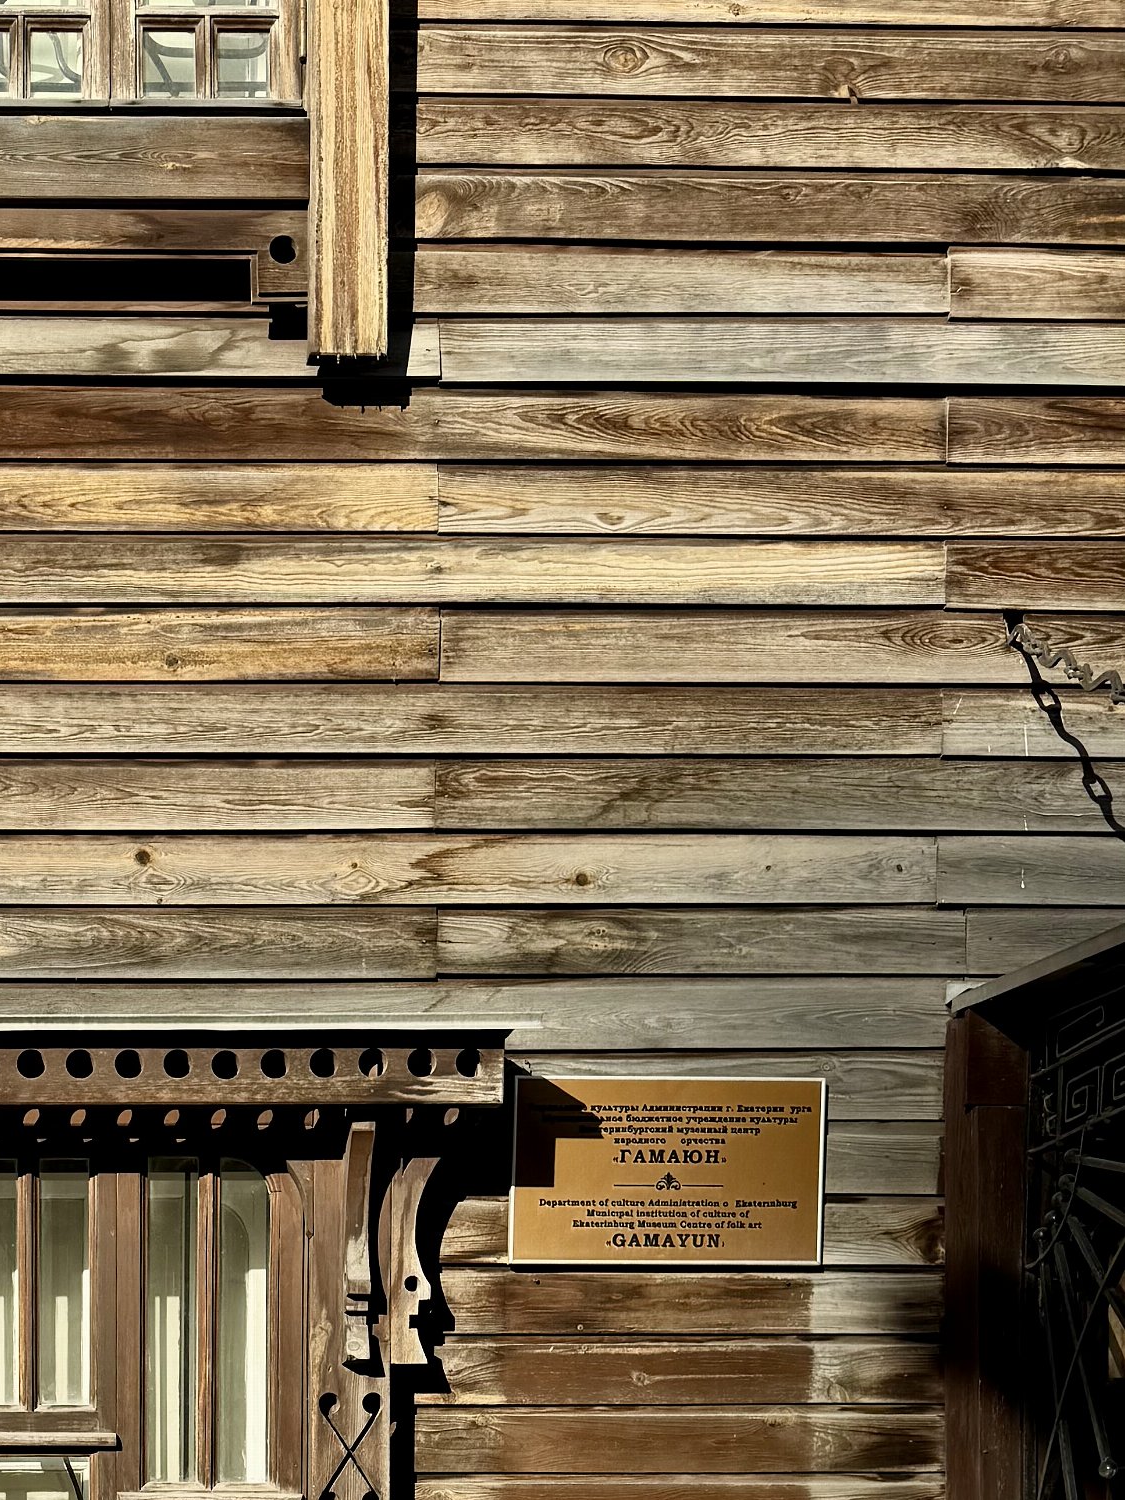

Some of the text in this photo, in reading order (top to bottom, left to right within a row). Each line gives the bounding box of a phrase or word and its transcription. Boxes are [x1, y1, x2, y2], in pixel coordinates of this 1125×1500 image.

[591, 1104, 638, 1113] культуры
[642, 1104, 722, 1113] Администрации
[626, 1114, 683, 1122] бюджетное
[686, 1115, 746, 1125] учреждение
[750, 1116, 798, 1125] культуры
[731, 1126, 761, 1136] центр
[614, 1137, 666, 1145] народного
[613, 1149, 727, 1164] «ГАМАЮН»
[539, 1199, 596, 1208] Department
[611, 1199, 645, 1207] culture
[648, 1199, 720, 1207] Administration
[587, 1209, 750, 1218] Municipal institution of culture of
[573, 1220, 634, 1229] Ekaterinburg
[637, 1220, 677, 1228] Museum
[680, 1220, 712, 1228] Centre
[715, 1220, 725, 1228] of
[727, 1220, 745, 1228] folk
